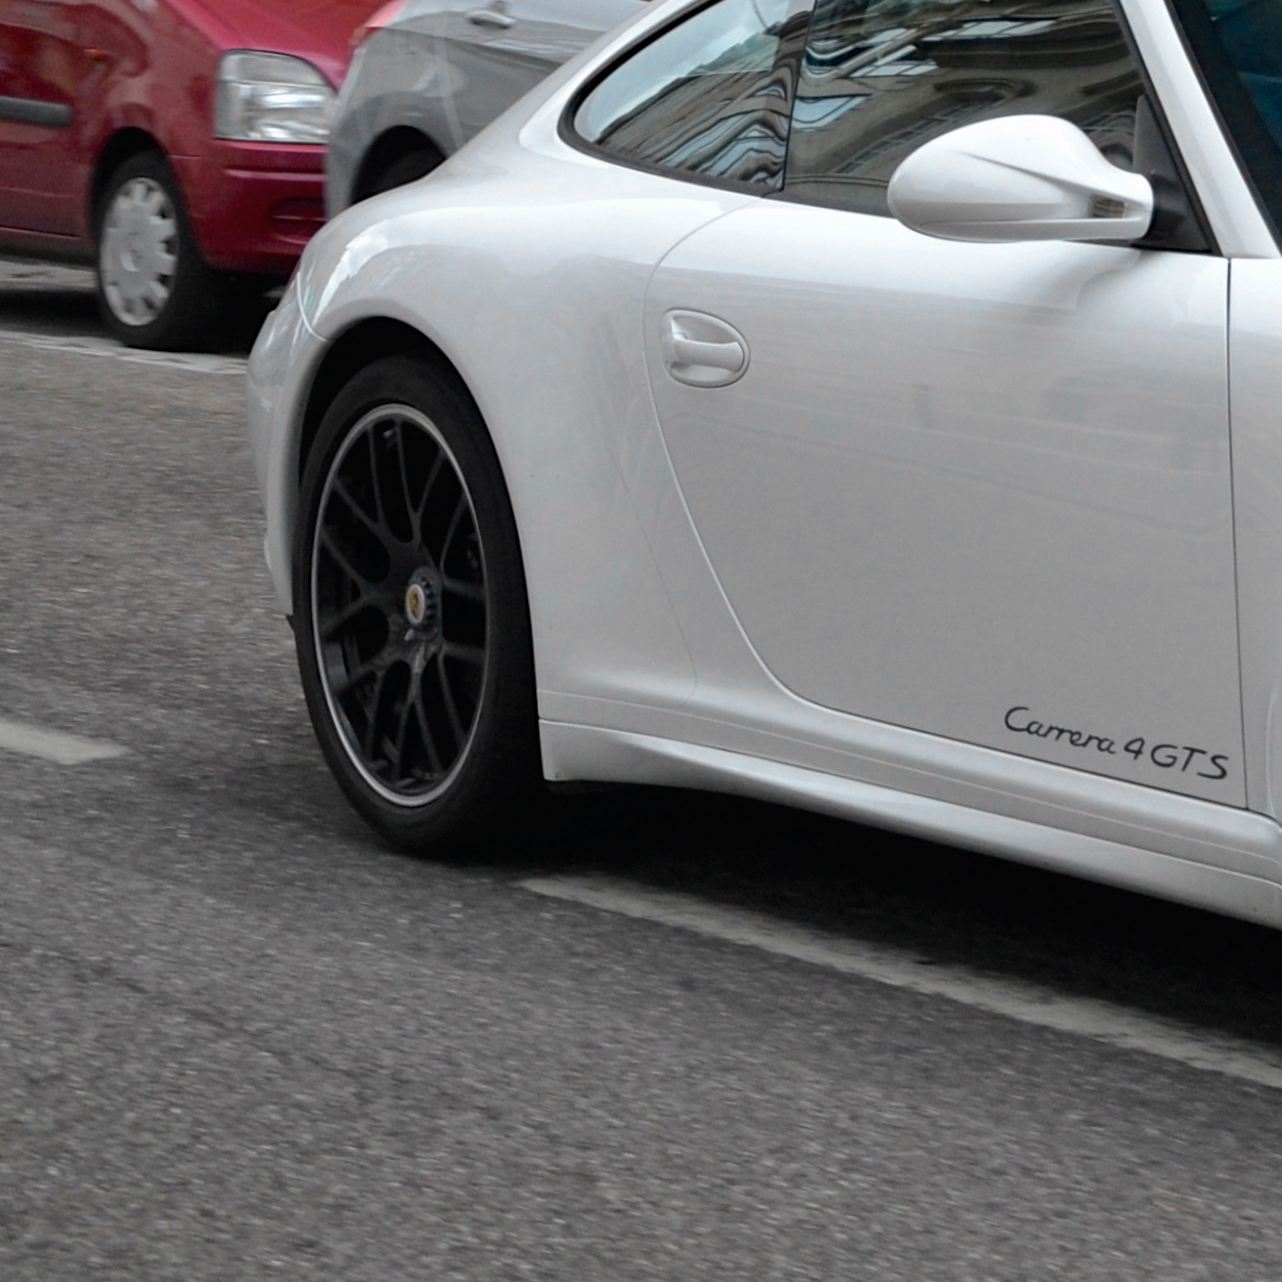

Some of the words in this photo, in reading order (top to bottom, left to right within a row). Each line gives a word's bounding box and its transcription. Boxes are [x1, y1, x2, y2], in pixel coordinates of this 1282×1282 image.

[1004, 706, 1116, 754] Carrera
[1123, 737, 1145, 761] 4
[1150, 744, 1230, 780] GTS
